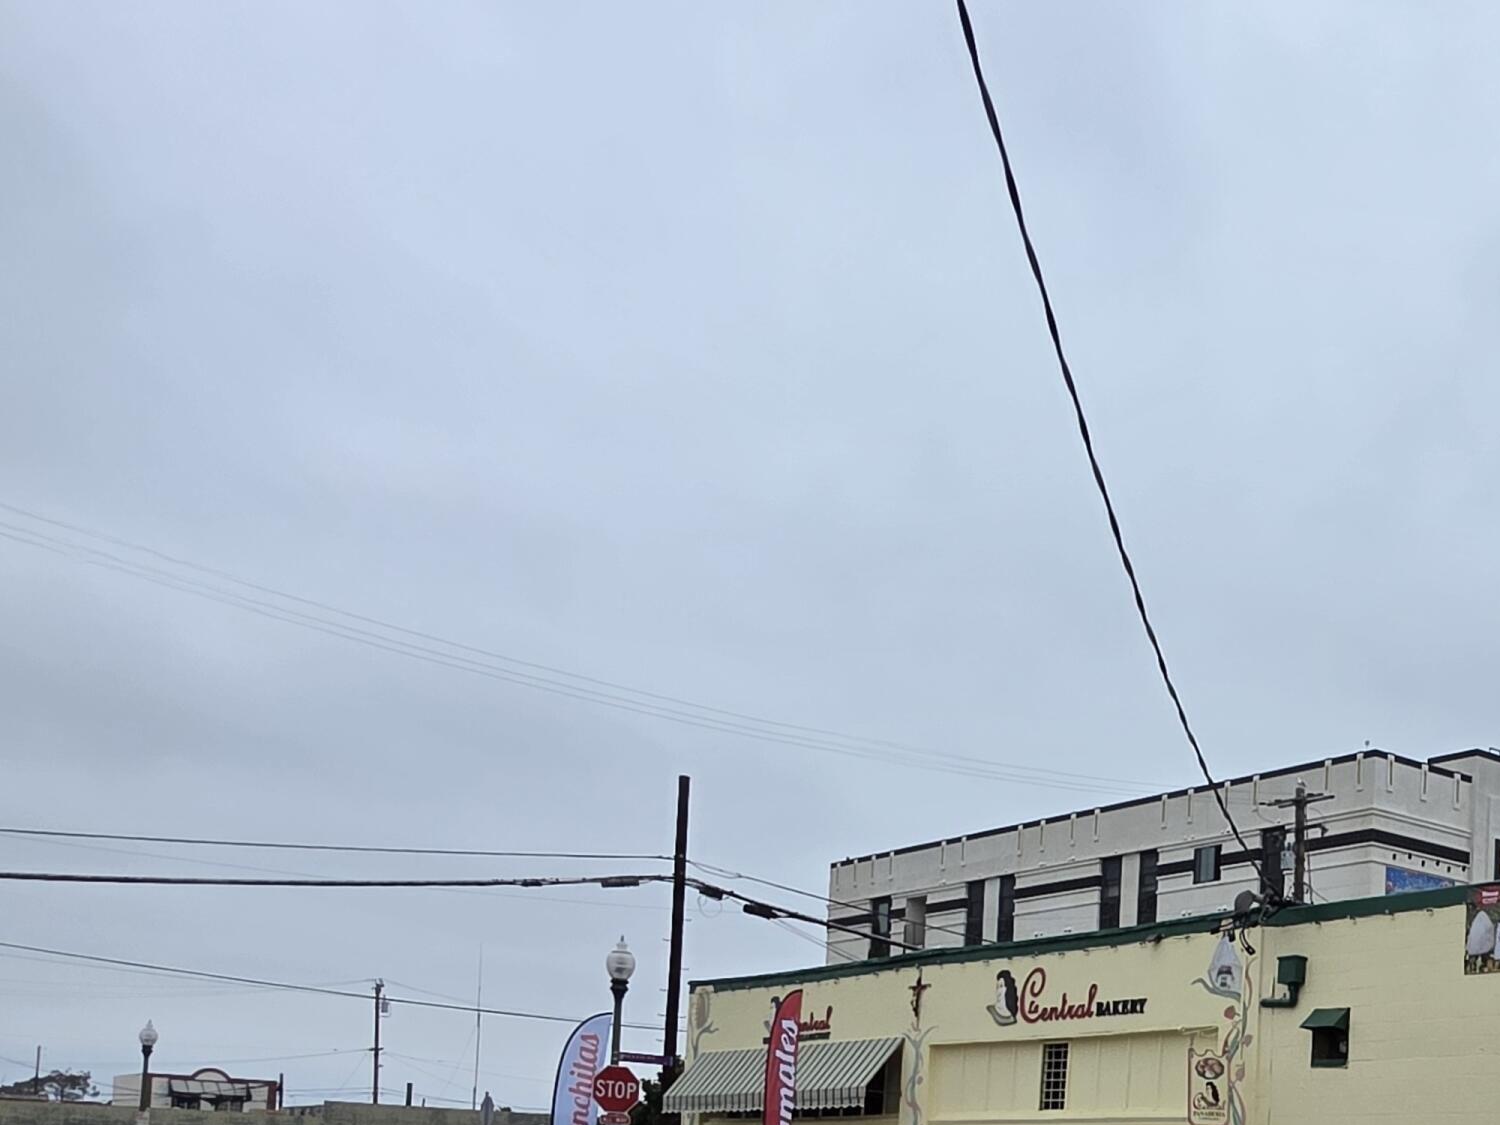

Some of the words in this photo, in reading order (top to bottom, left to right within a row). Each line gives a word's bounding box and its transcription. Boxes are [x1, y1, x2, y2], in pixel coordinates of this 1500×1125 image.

[1020, 967, 1097, 1024] Central
[1095, 998, 1147, 1017] BAKERY
[797, 1005, 833, 1032] ntral
[595, 1079, 637, 1100] STOP
